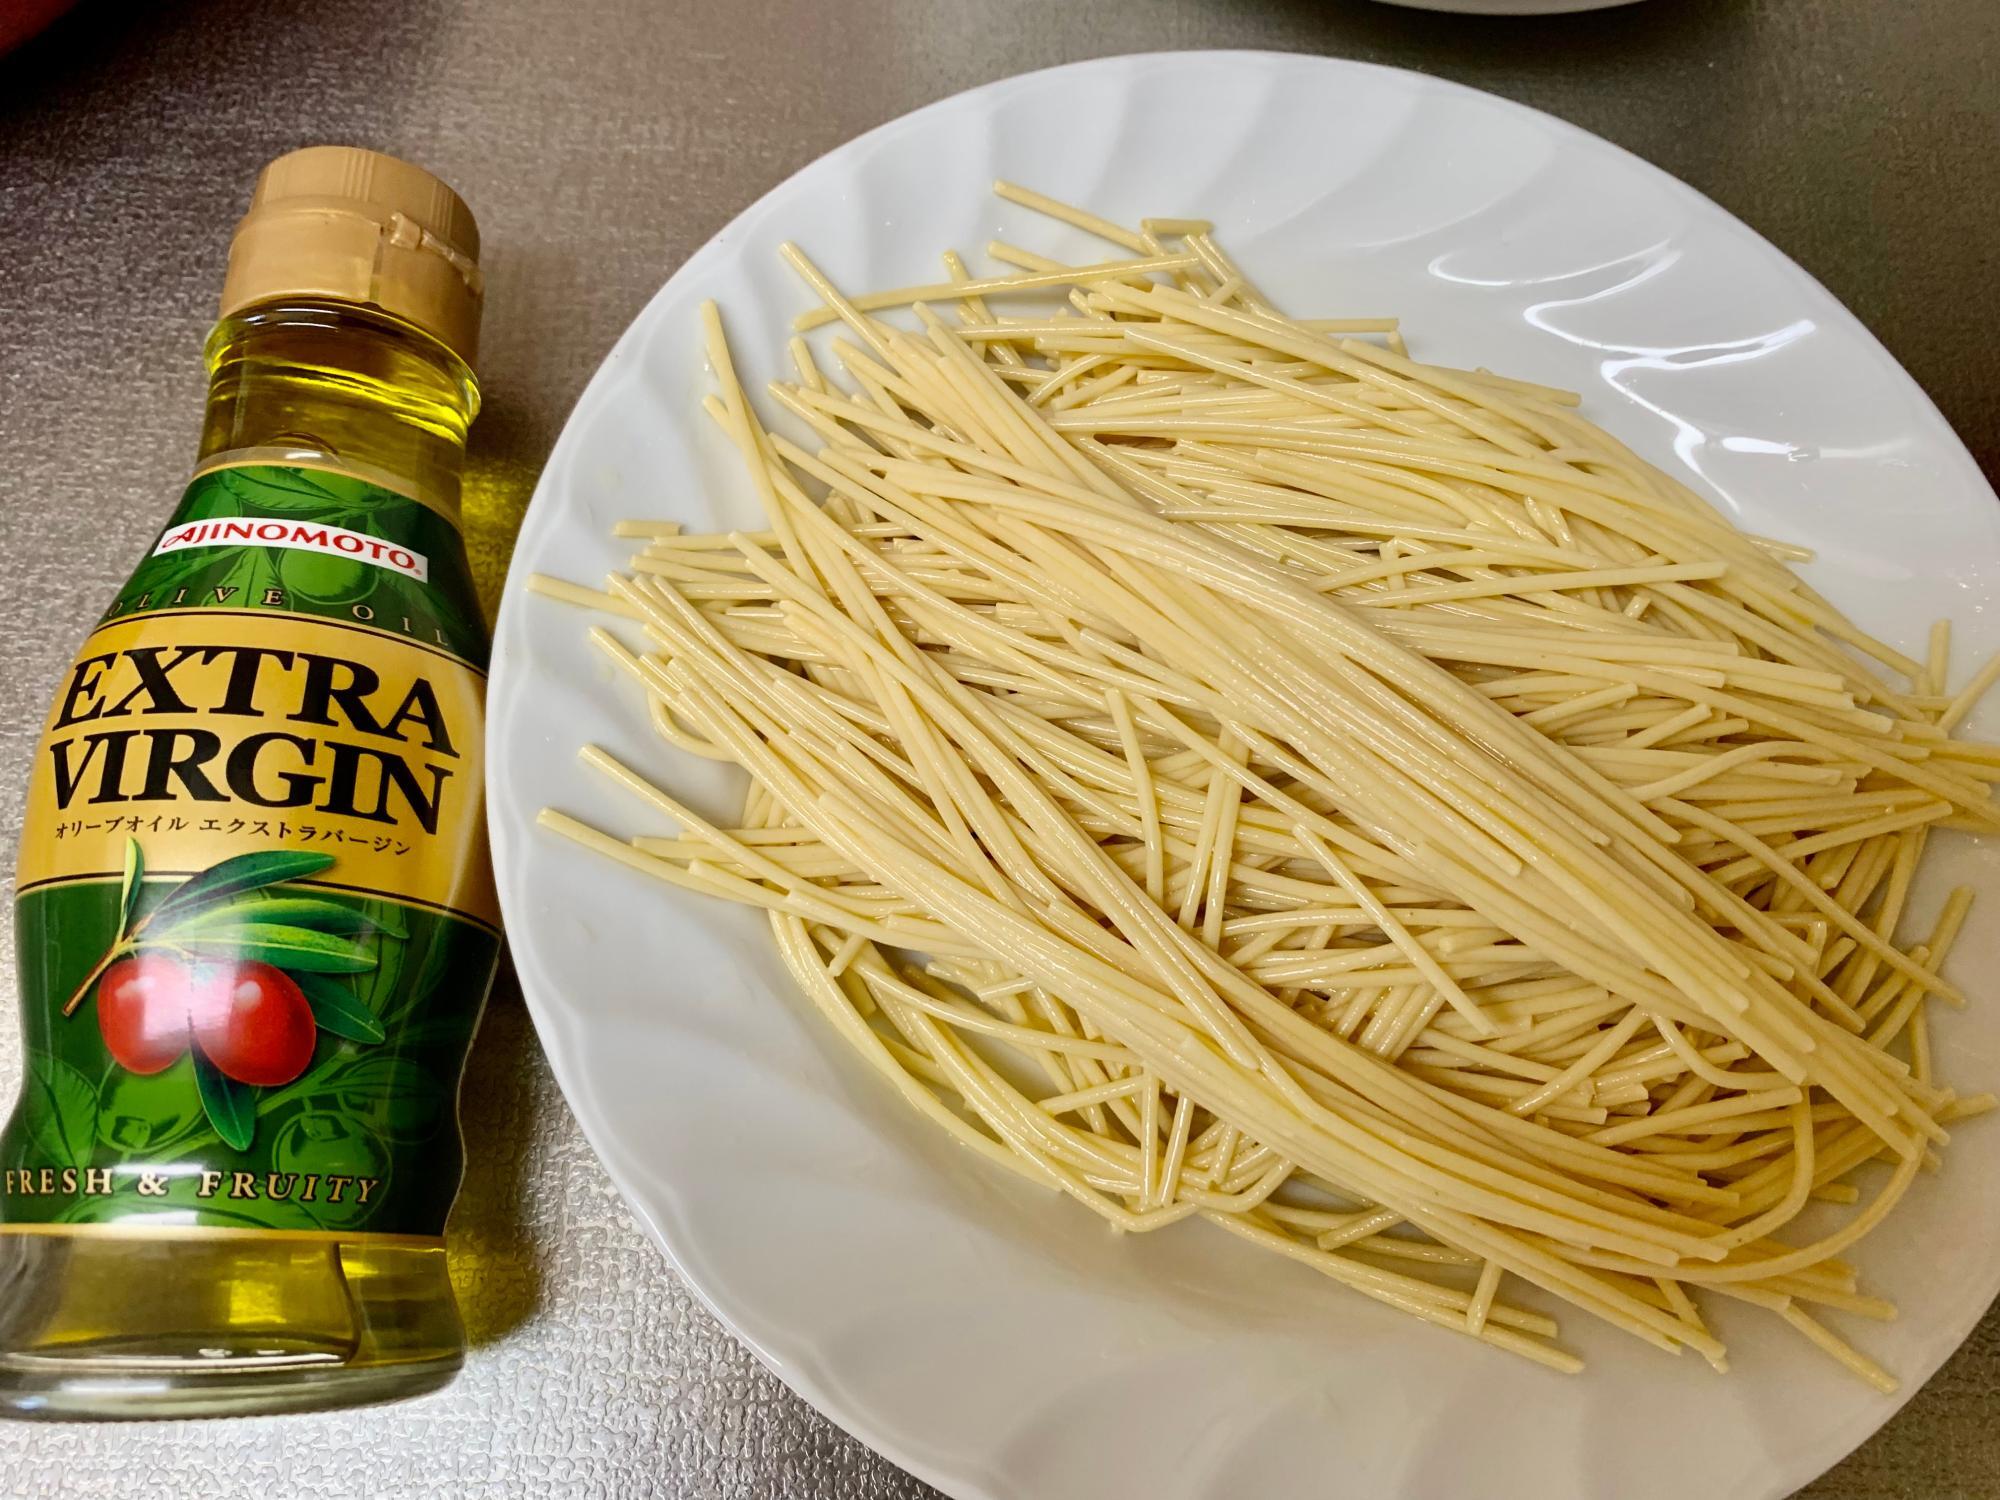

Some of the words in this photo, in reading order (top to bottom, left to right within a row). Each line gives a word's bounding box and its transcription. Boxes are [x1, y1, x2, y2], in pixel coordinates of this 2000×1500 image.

[352, 604, 448, 647] OIL
[52, 645, 460, 760] EXTRA
[50, 728, 454, 835] VIRGIN
[55, 814, 190, 839] オリーブオイル
[199, 816, 412, 856] エクストラバージン
[6, 1167, 113, 1195] FRESH
[137, 1170, 169, 1196] &
[199, 1170, 381, 1203] FRUITY
